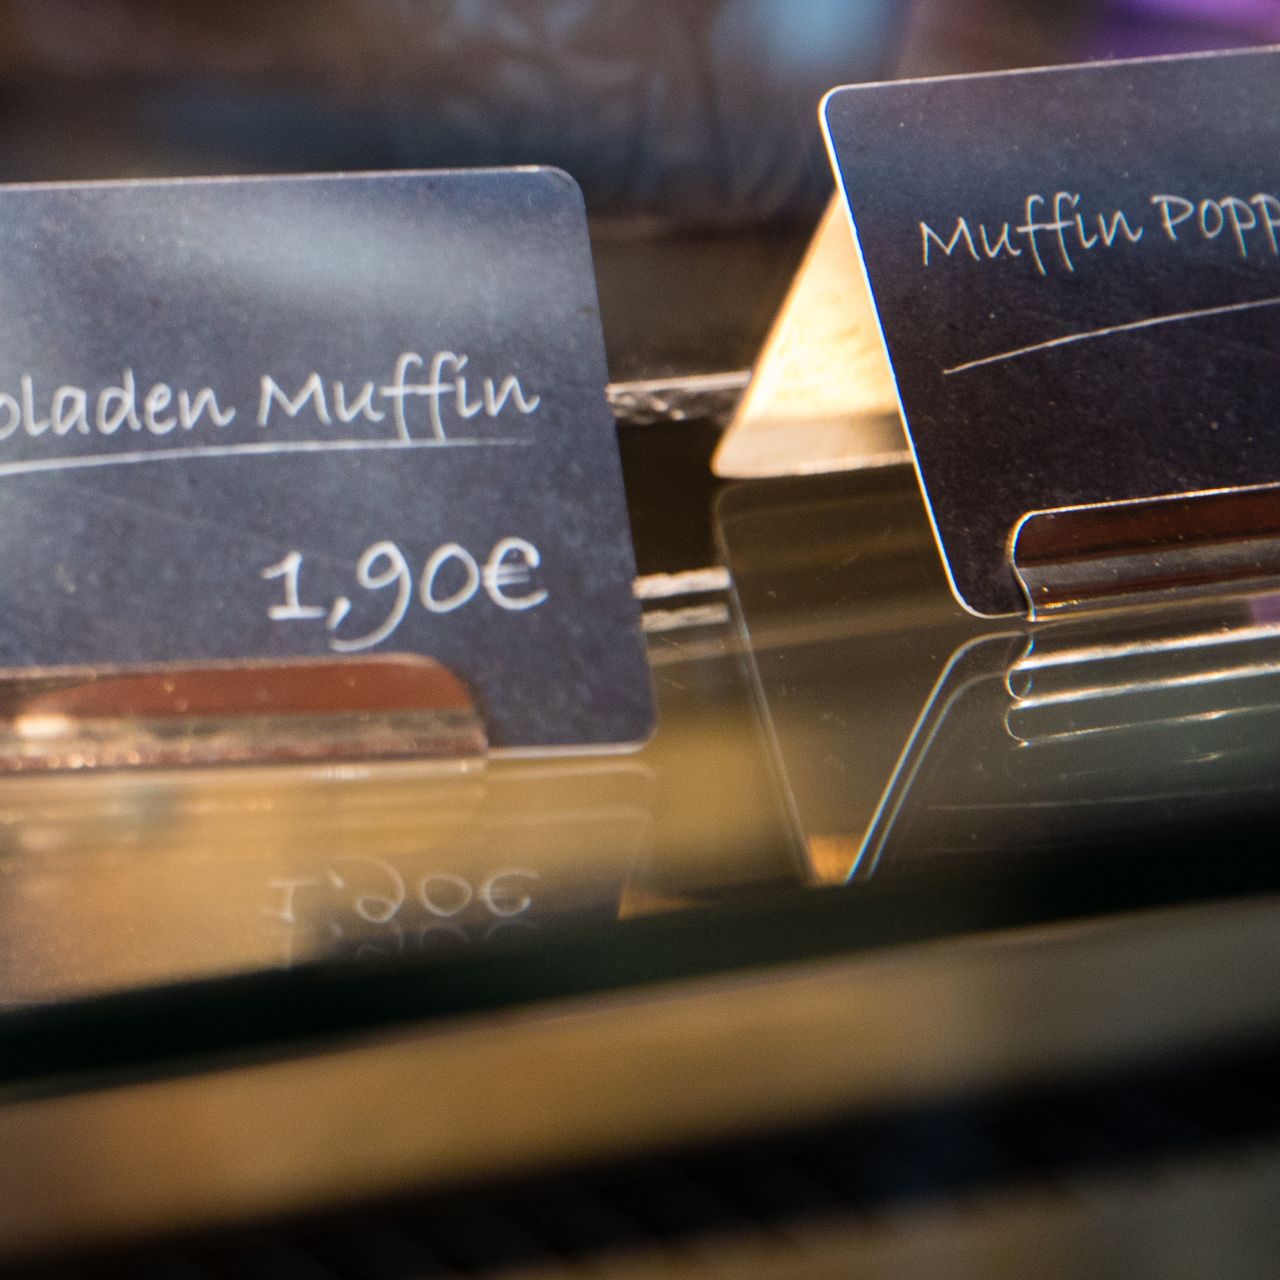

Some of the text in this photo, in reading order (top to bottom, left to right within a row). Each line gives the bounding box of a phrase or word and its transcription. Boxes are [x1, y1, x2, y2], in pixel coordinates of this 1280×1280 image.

[920, 190, 1144, 274] Muffin
[256, 350, 542, 446] Muffin
[262, 536, 548, 652] 1,90€
